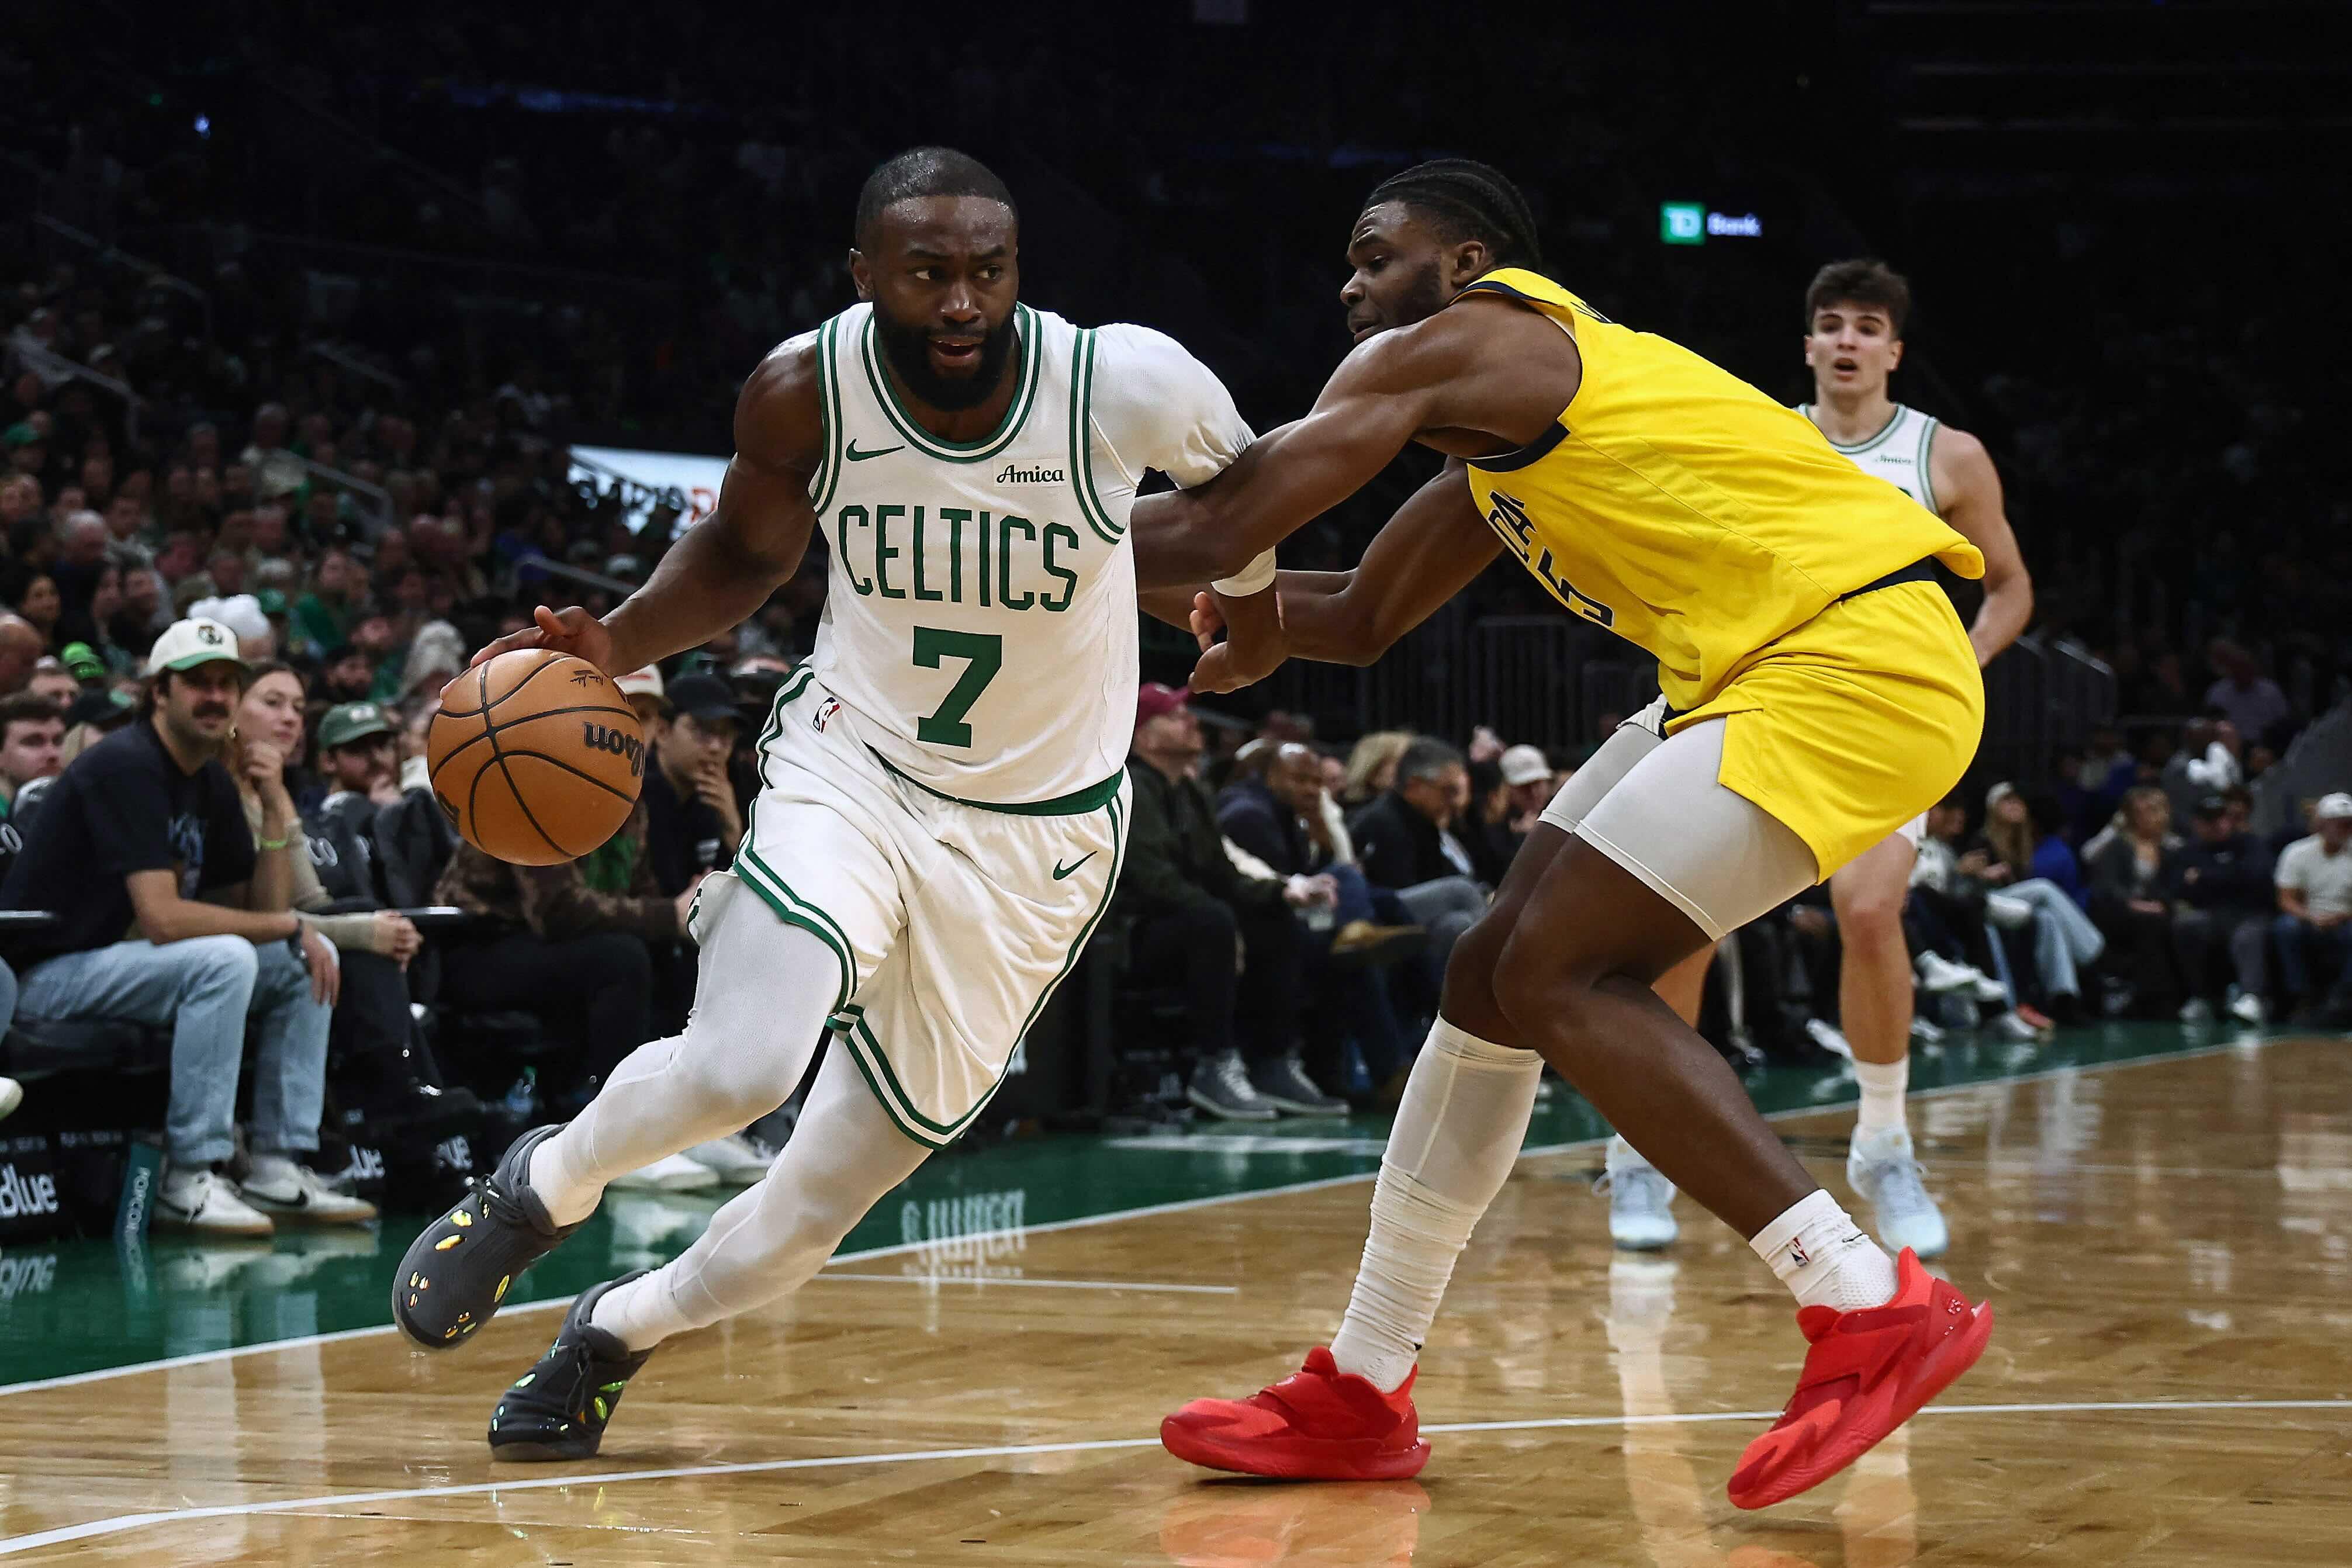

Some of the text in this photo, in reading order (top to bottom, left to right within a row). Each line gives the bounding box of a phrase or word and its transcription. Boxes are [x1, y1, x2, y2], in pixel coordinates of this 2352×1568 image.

[1666, 207, 1701, 237] TD
[996, 464, 1065, 483] Amica
[838, 505, 1079, 612] CELTICS
[912, 625, 1002, 748] 7
